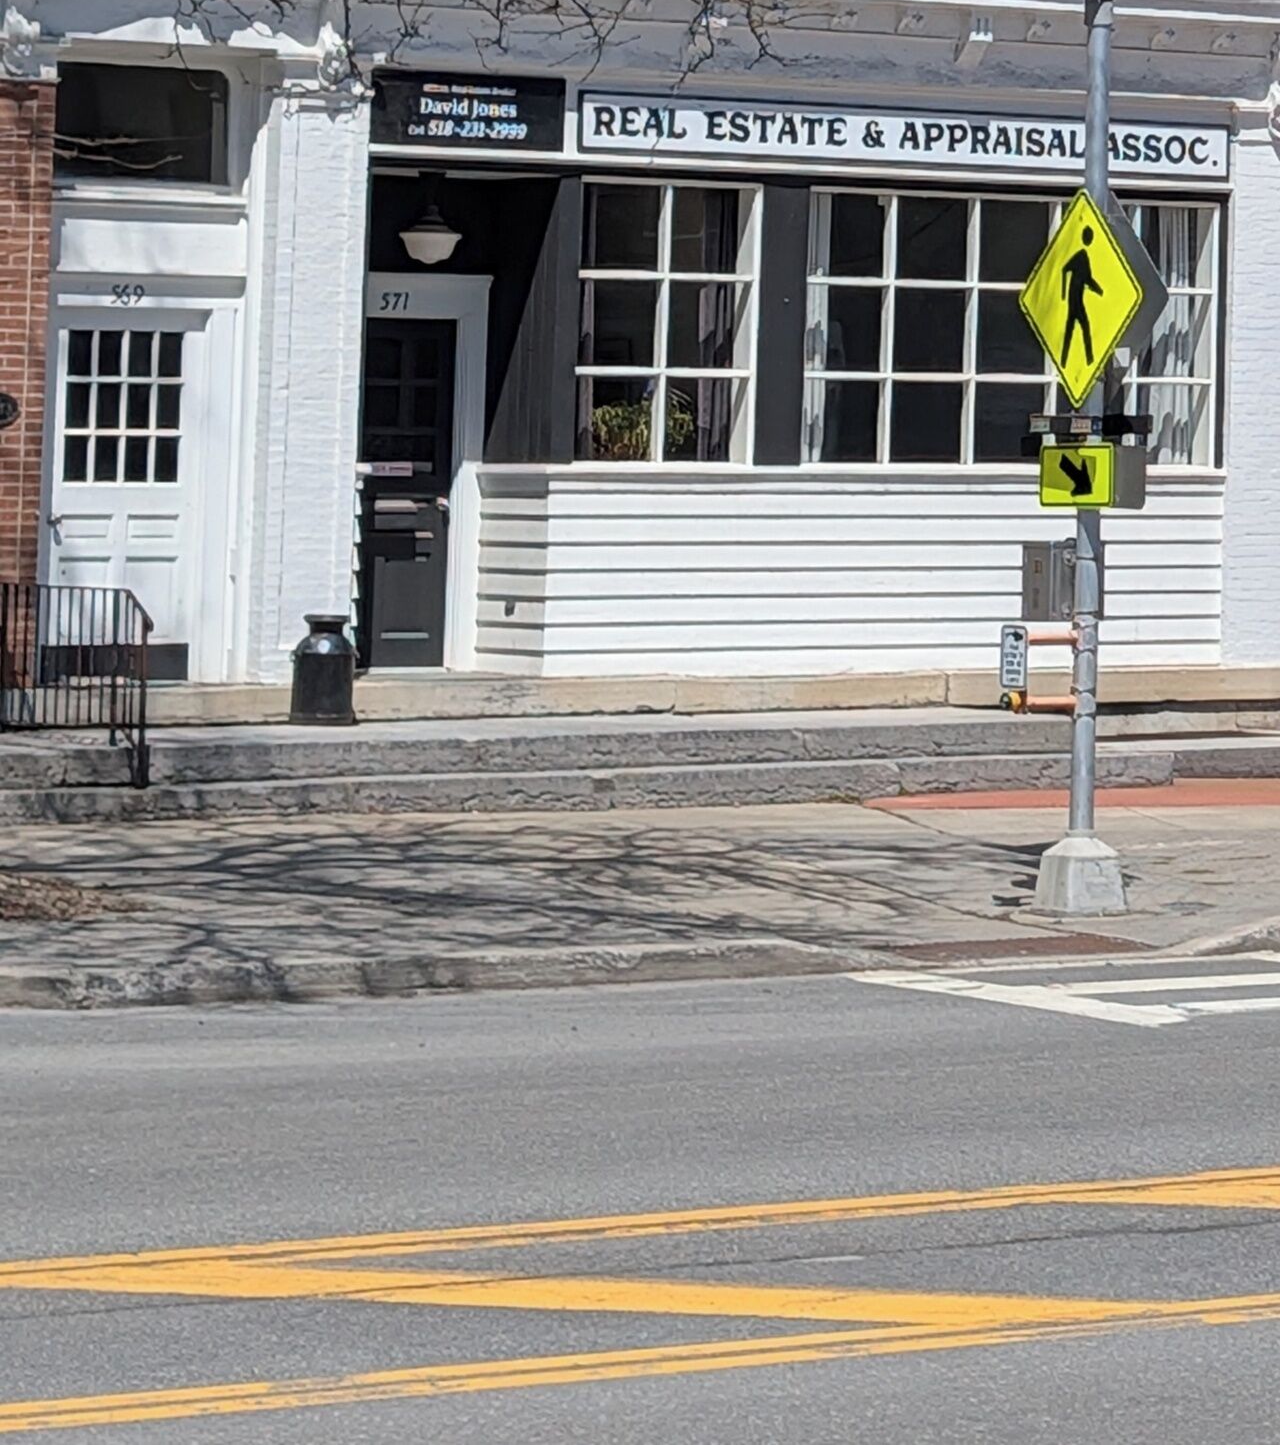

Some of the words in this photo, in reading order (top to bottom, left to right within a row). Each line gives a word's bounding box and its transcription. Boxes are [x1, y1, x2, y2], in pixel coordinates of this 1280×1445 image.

[420, 97, 469, 115] David
[470, 98, 518, 119] Jones
[593, 106, 687, 139] REAL
[704, 111, 848, 146] ESTATE
[862, 119, 886, 149] &
[899, 122, 1086, 159] APPRAISAL
[110, 284, 145, 306] 569
[379, 291, 409, 311] 571
